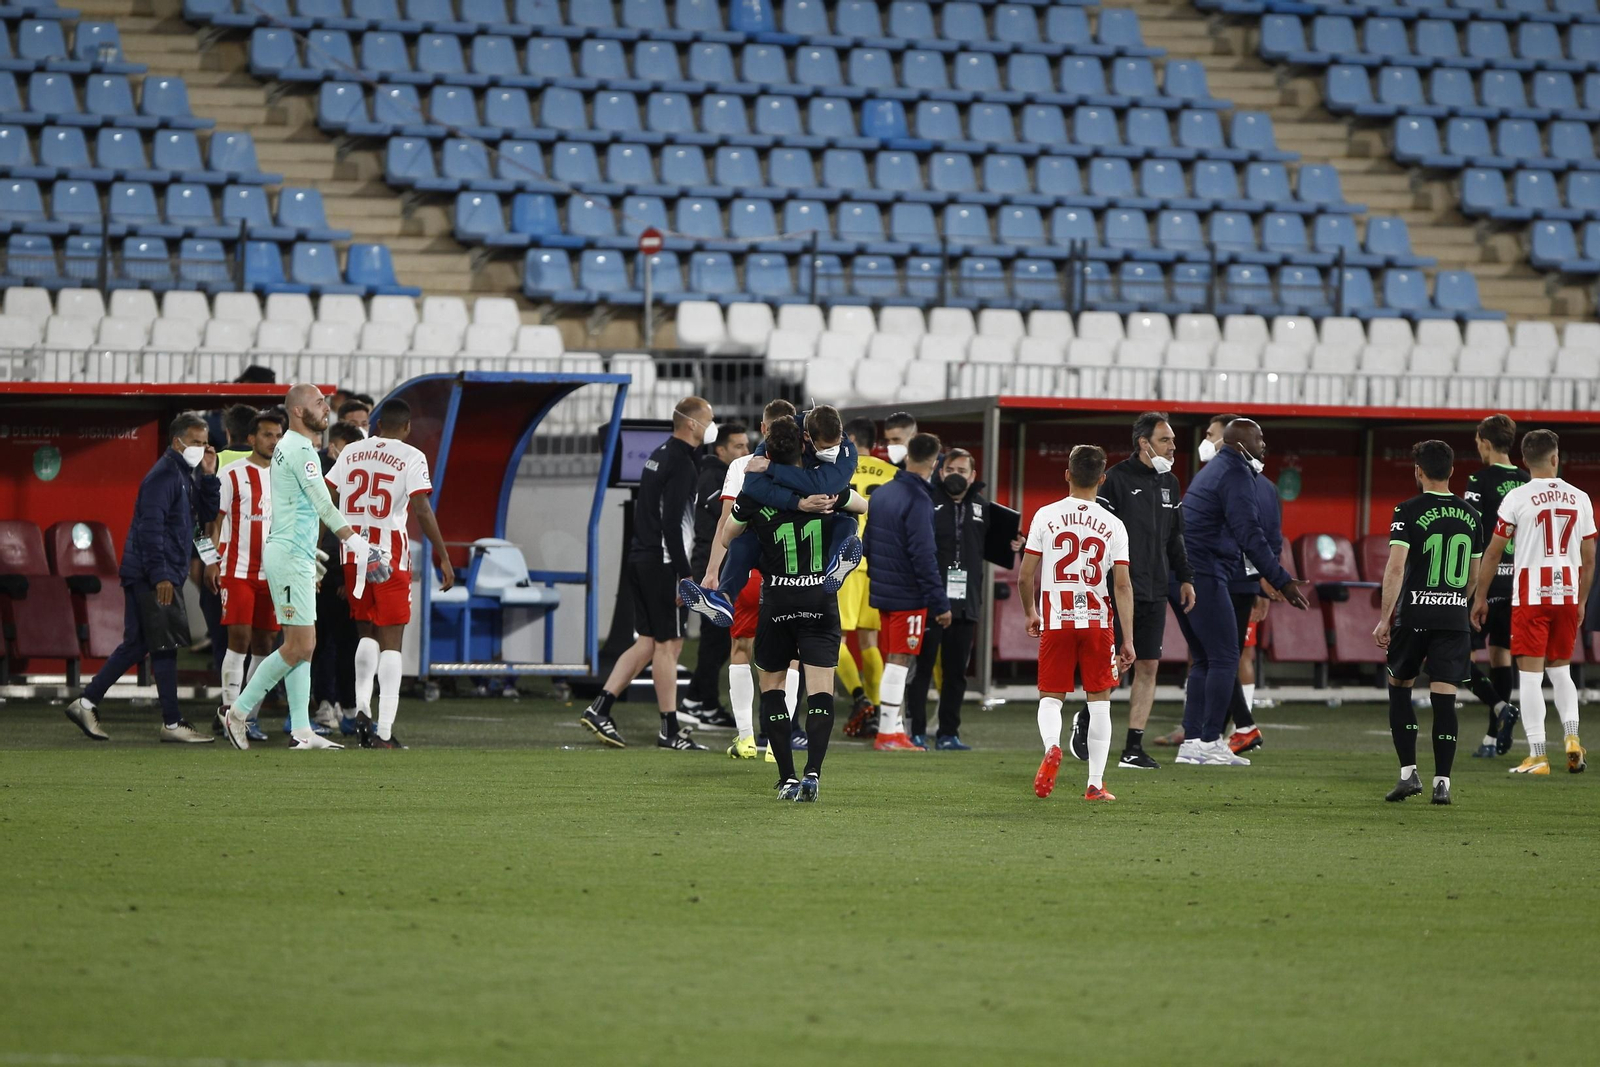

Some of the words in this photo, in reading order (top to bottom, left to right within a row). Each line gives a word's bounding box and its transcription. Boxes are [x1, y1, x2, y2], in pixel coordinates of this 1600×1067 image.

[346, 450, 406, 472] FERNANDES
[345, 468, 395, 520] 25
[1531, 490, 1577, 506] CORPAS
[1061, 512, 1113, 542] VILLALBA
[1535, 508, 1578, 557] 17
[773, 518, 823, 575] 11
[1052, 531, 1106, 587] 23
[1423, 533, 1472, 588] 10
[283, 585, 291, 603] 1
[907, 615, 922, 635] 11
[769, 712, 790, 722] CDL
[808, 708, 829, 716] CDL
[1438, 734, 1457, 742] CDL
